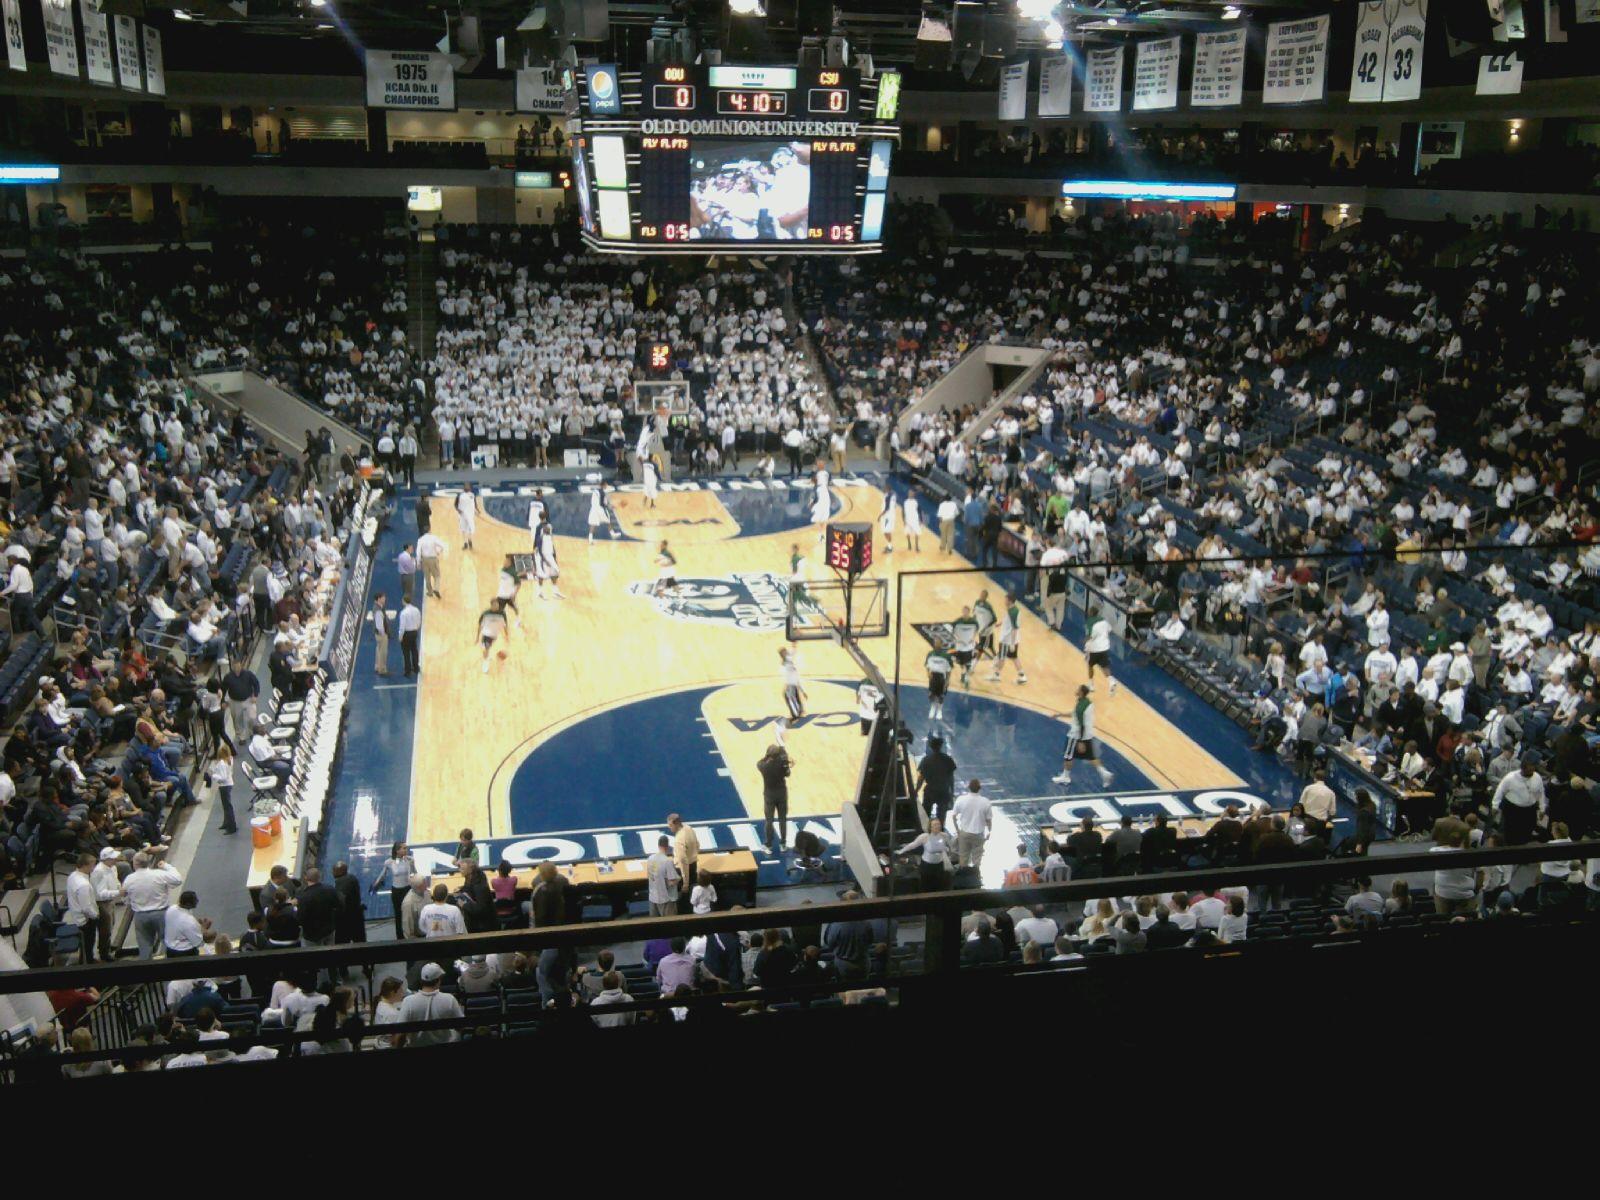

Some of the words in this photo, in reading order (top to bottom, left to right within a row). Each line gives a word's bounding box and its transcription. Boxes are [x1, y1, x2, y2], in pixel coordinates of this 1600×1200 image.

[394, 63, 428, 81] 1975
[1357, 51, 1378, 83] 42
[1393, 47, 1414, 81] 33
[664, 67, 685, 82] ODU
[819, 72, 840, 85] CSU
[385, 82, 411, 93] NCAA
[384, 94, 440, 105] CHAMPIONS
[595, 100, 615, 108] pepsi
[676, 87, 690, 108] 0
[730, 93, 770, 112] 4:10
[829, 91, 843, 111] 0
[642, 119, 675, 135] OLD
[678, 120, 760, 136] DOMINION
[763, 121, 860, 137] UNIVERSITY
[832, 541, 850, 567] 35
[1049, 791, 1271, 824] OLD
